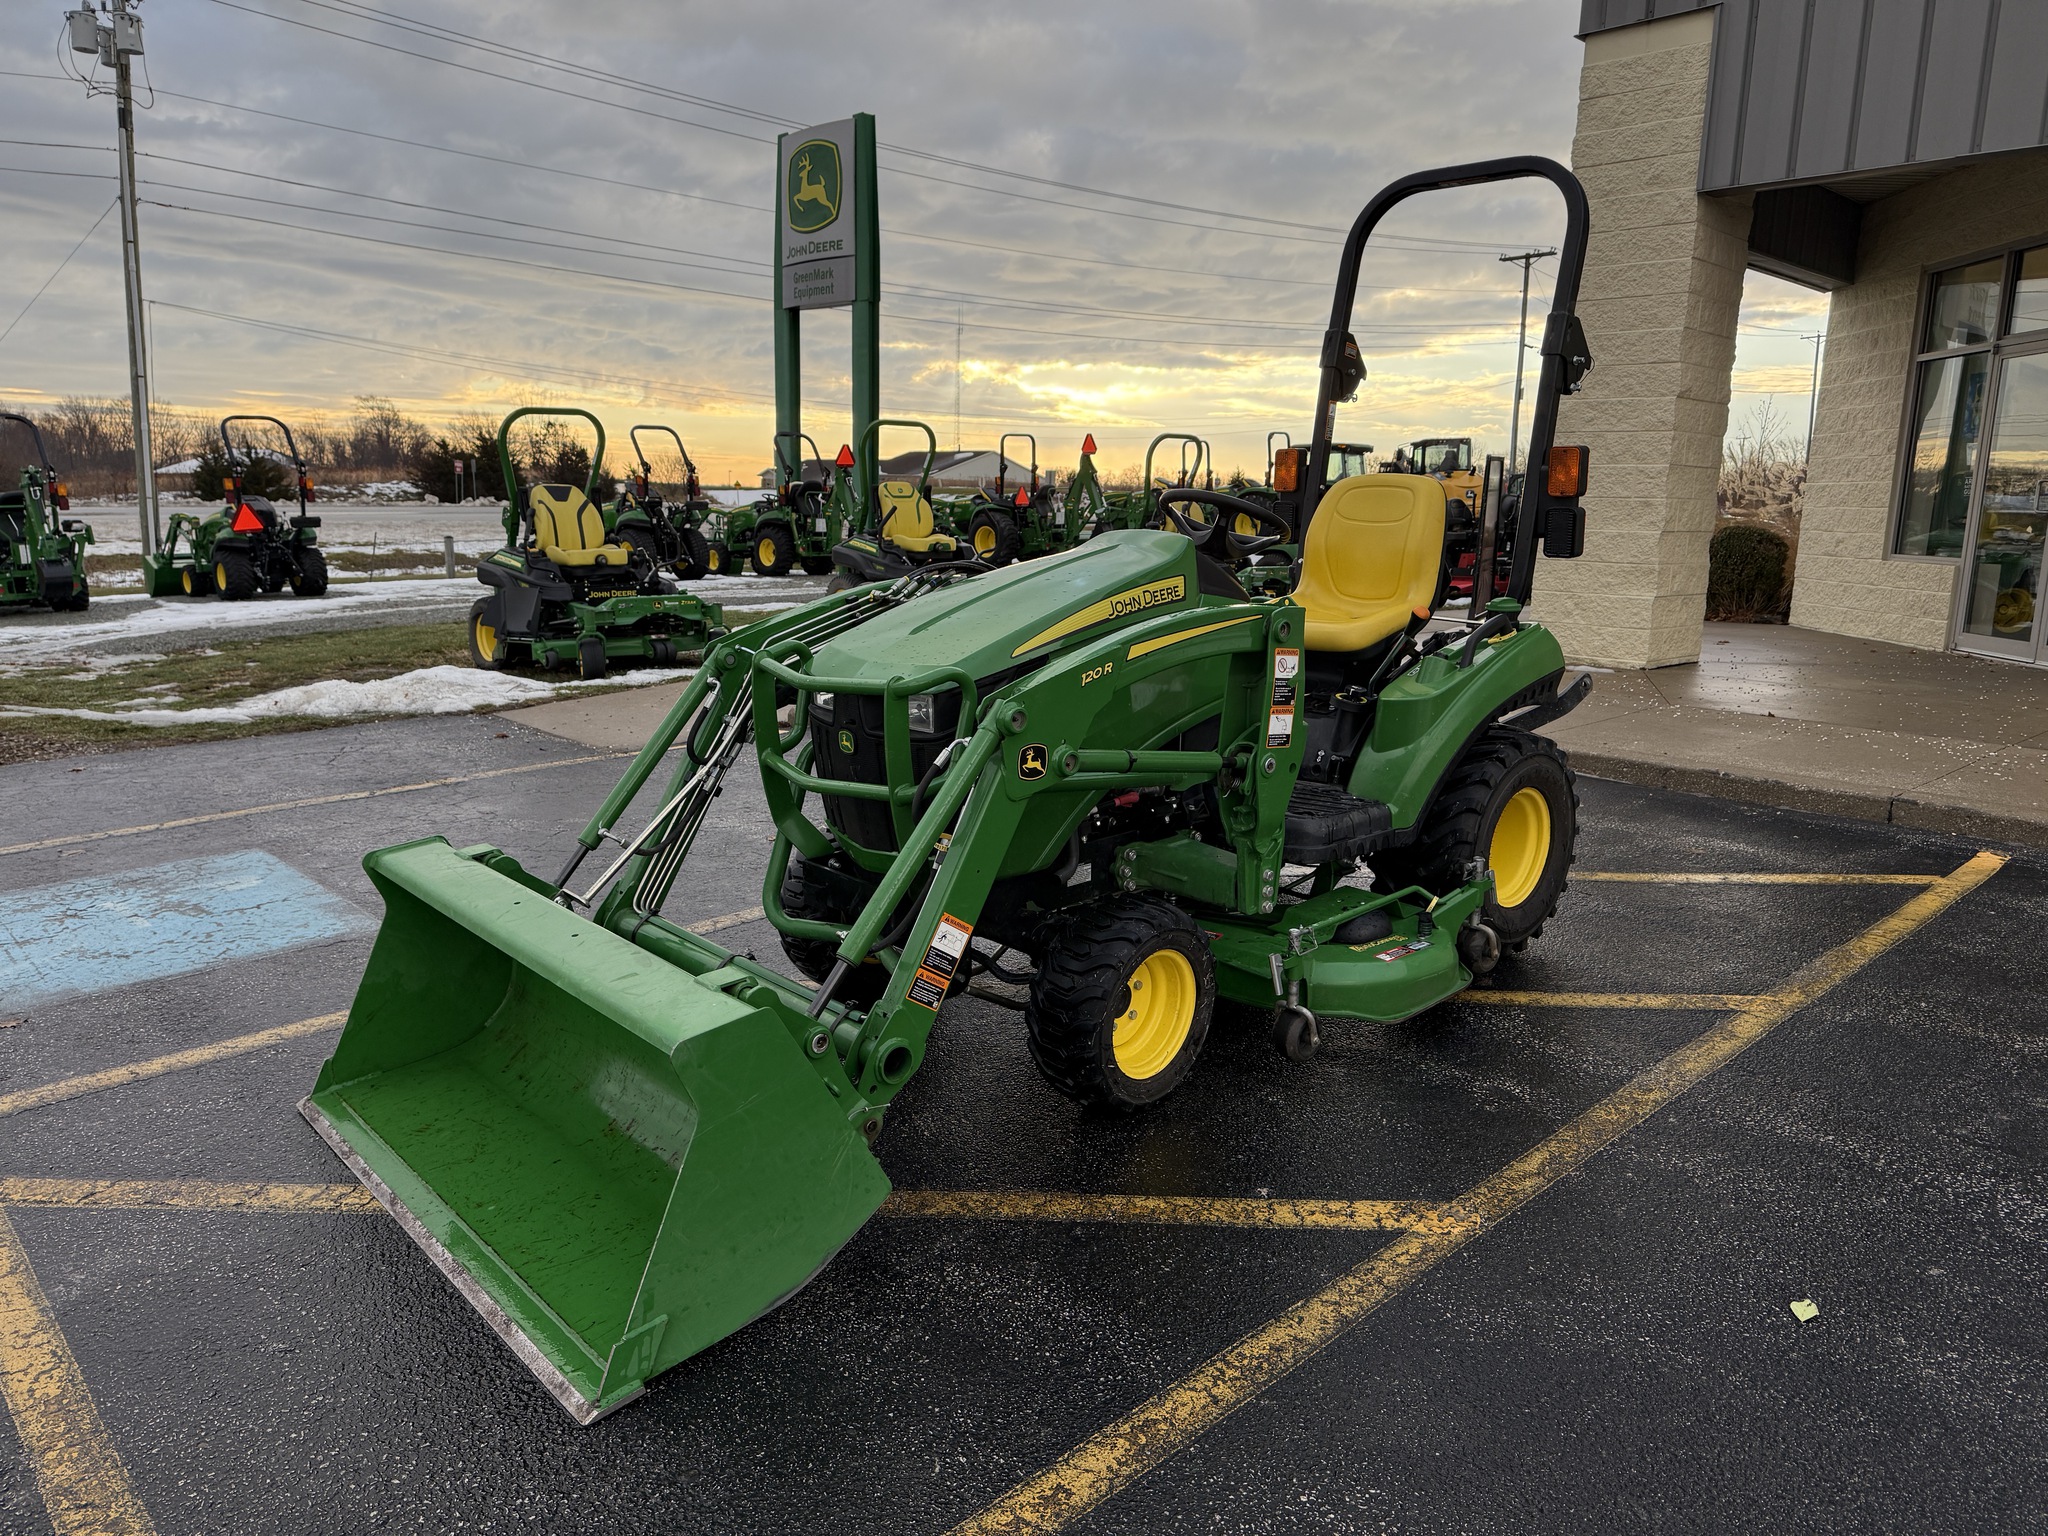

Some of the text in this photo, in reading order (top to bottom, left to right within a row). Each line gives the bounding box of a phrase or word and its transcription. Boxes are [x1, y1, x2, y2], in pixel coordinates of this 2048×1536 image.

[787, 239, 844, 259] JOHN DEERE
[793, 267, 834, 284] GreenMark
[793, 282, 835, 300] Equipment
[588, 589, 637, 598] JOHN DEERE
[1108, 584, 1181, 617] JOHN DEERE
[1081, 662, 1113, 687] 120 R
[949, 919, 970, 932] WARNING
[925, 973, 946, 987] WARNING
